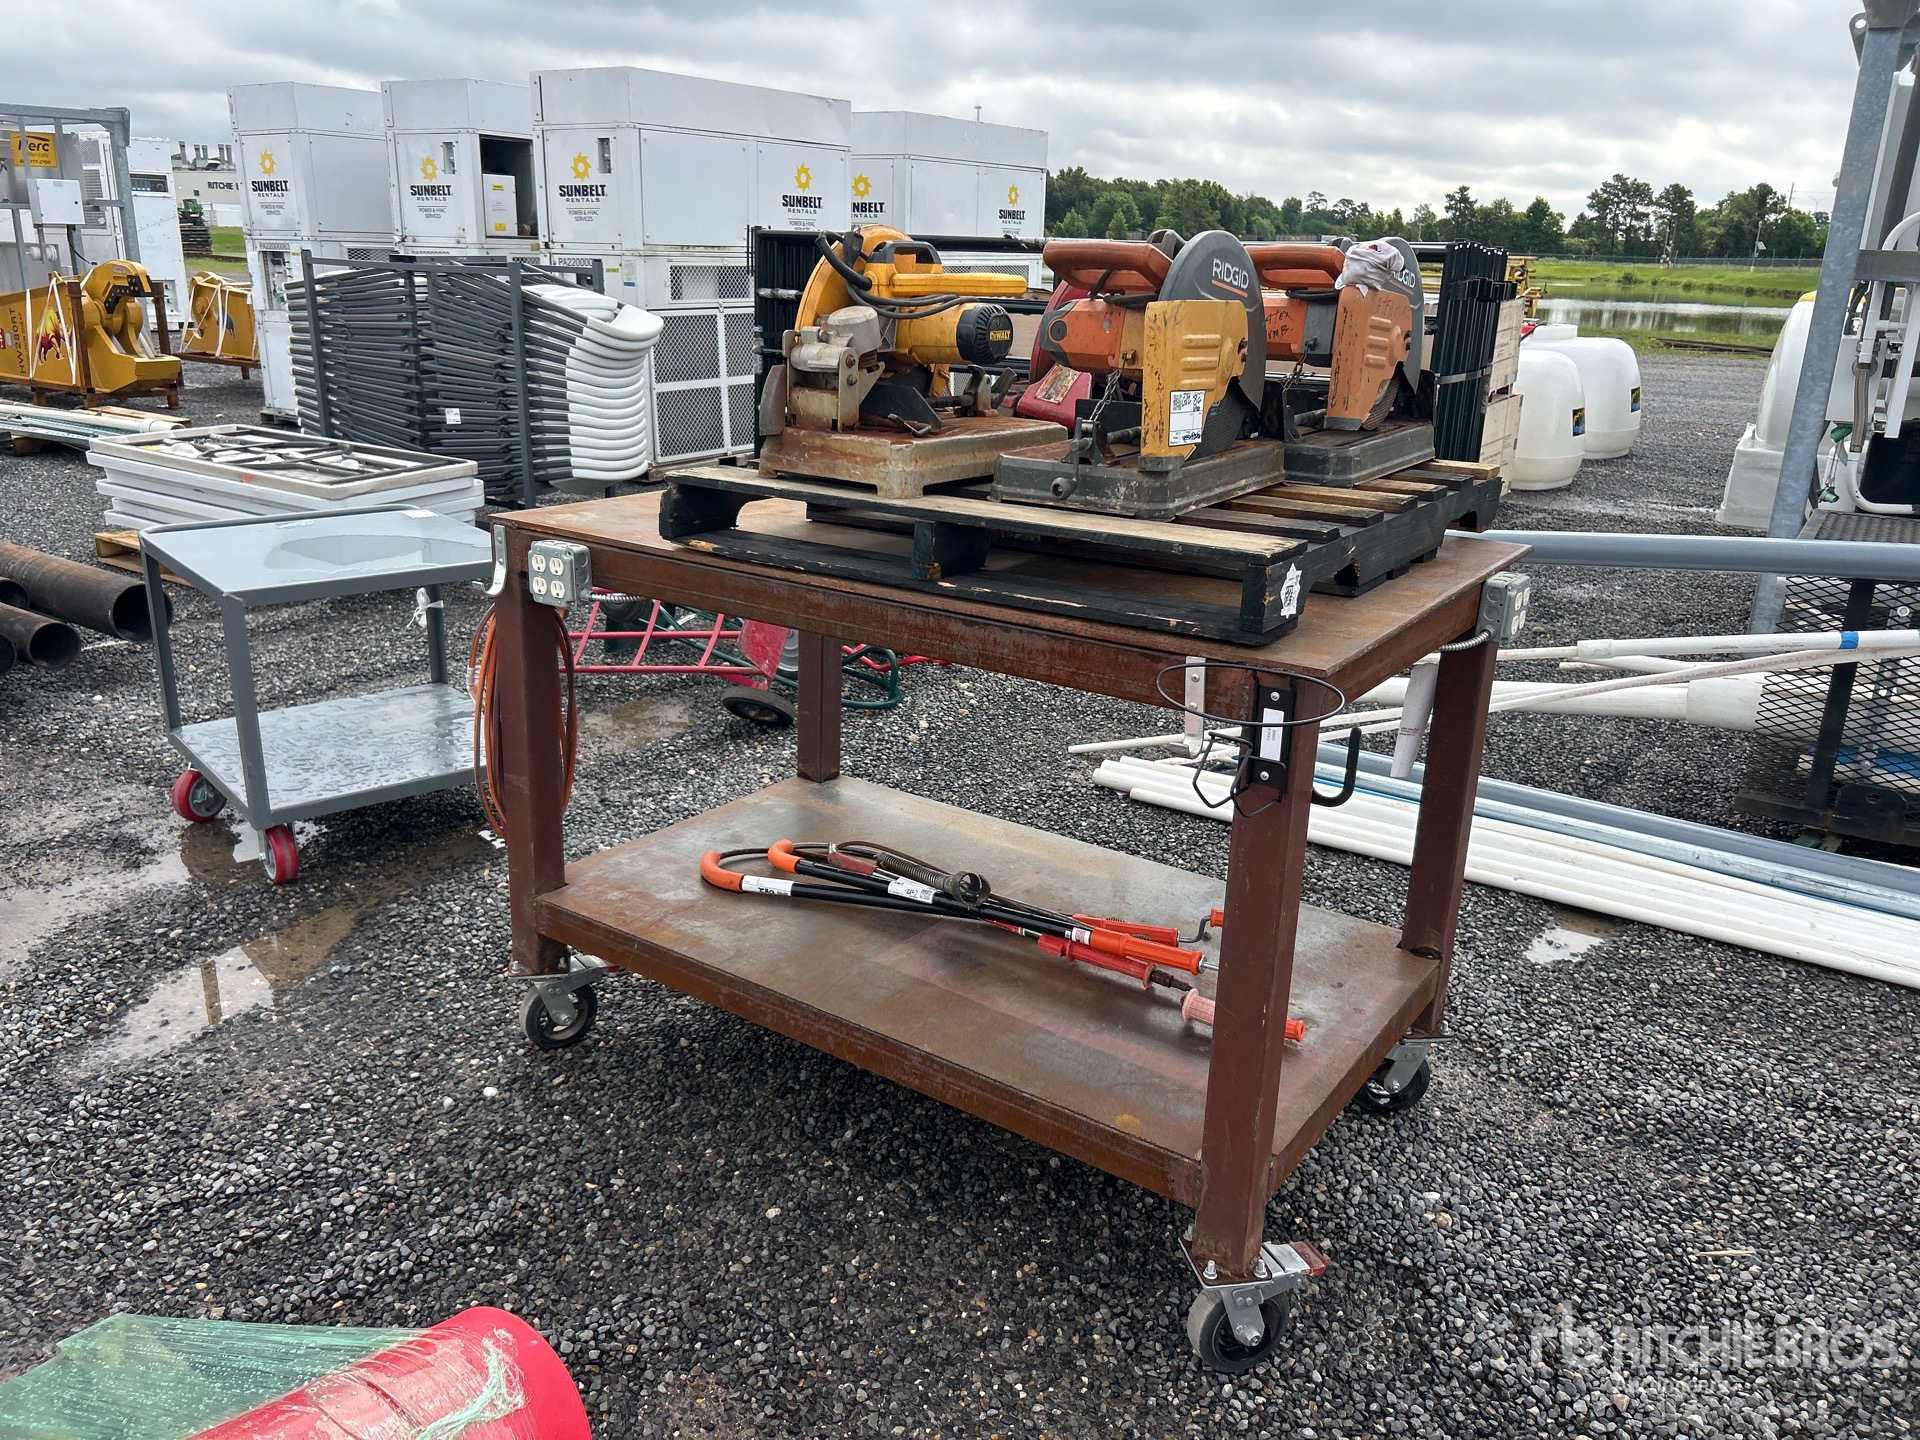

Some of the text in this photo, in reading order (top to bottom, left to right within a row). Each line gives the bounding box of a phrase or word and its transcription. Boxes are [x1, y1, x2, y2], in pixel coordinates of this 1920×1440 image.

[207, 181, 234, 190] RITCHIE
[251, 180, 289, 192] SUNBELT
[410, 184, 452, 197] SUNBELT
[558, 184, 607, 197] SUNBELT
[782, 194, 823, 209] SUNBELT
[851, 202, 885, 213] NBELT
[998, 209, 1026, 220] SUNBELT
[1212, 257, 1250, 290] RIDGID
[1392, 269, 1416, 288] IDGID
